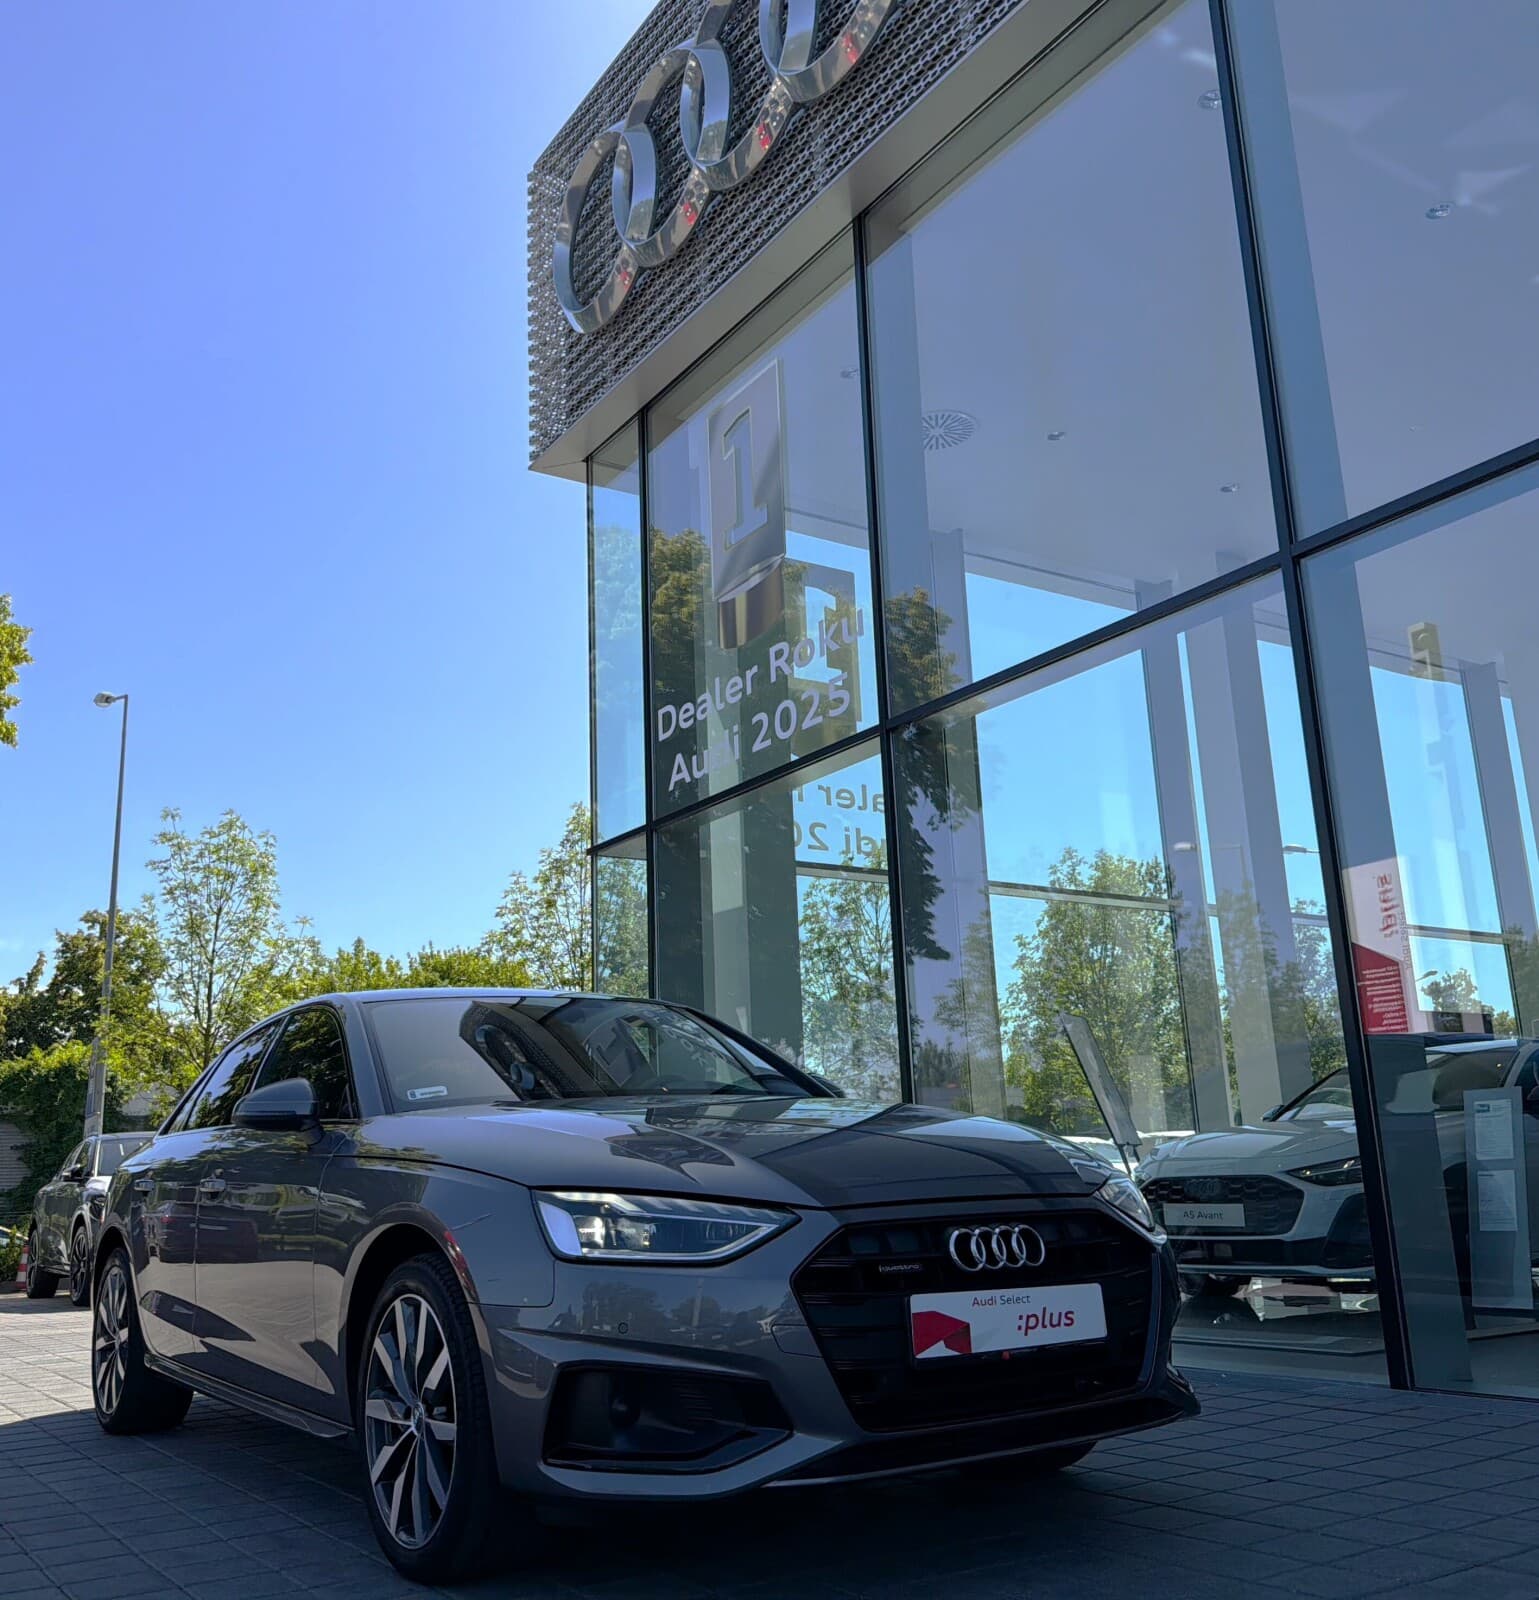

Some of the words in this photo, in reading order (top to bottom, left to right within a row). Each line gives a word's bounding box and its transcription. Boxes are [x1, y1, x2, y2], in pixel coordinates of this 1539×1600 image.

[657, 664, 758, 742] Dealer
[768, 608, 865, 684] Roku
[668, 724, 740, 792] Audi
[751, 671, 850, 753] 2025
[1197, 1210, 1224, 1221] Avant
[972, 1295, 997, 1308] Audi
[1000, 1294, 1031, 1306] Select
